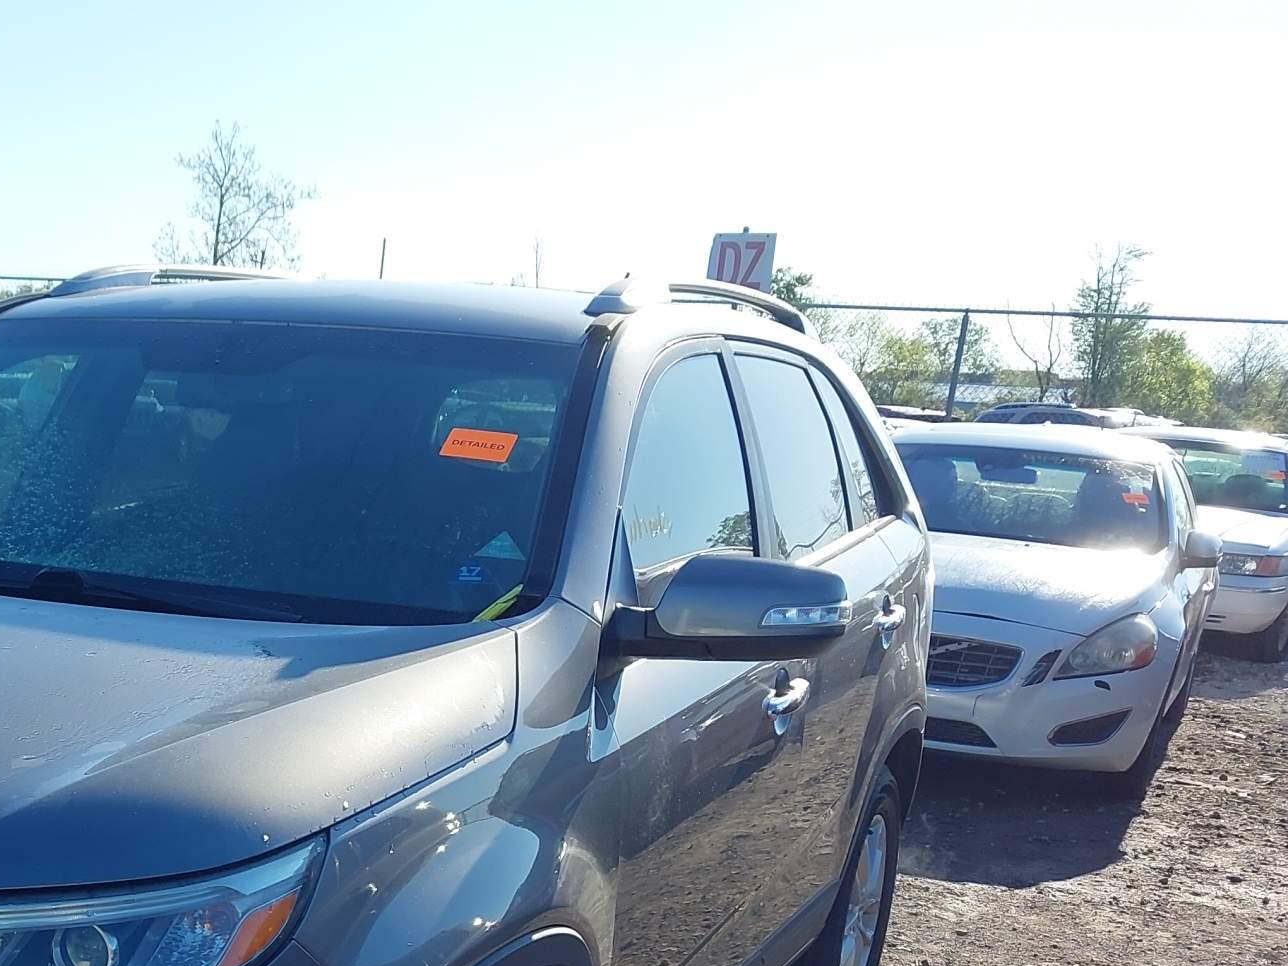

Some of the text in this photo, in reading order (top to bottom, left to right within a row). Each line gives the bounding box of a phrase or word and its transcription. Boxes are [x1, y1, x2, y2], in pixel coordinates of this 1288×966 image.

[716, 240, 766, 291] DZ
[451, 439, 505, 451] DETAILED
[459, 566, 481, 576] 17
